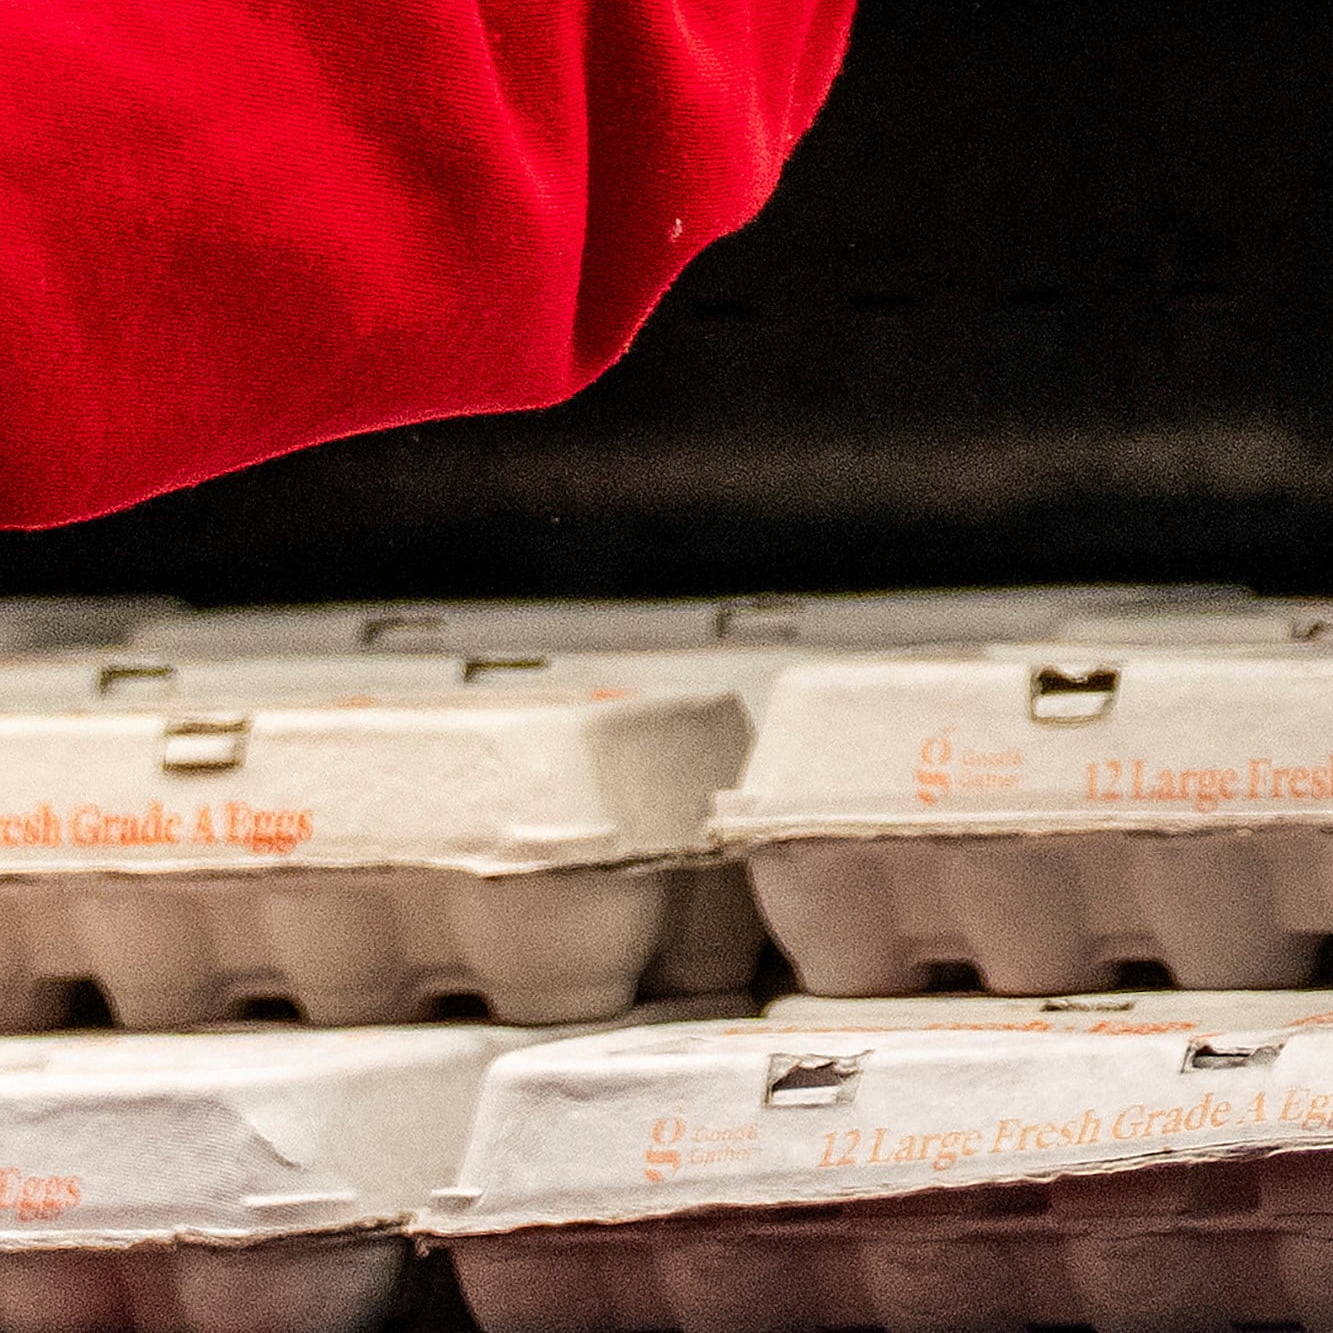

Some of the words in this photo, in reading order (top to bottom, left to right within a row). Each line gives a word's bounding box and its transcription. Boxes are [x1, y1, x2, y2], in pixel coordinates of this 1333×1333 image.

[1086, 760, 1123, 801] 12
[1132, 759, 1239, 813] Large
[71, 800, 180, 847] Grade
[193, 803, 216, 845] A
[224, 800, 314, 856] Eggs
[818, 1127, 862, 1168] 12
[868, 1127, 983, 1172] Large
[991, 1108, 1102, 1155] Fresh
[1110, 1090, 1233, 1141] Grade
[1238, 1090, 1266, 1125] A
